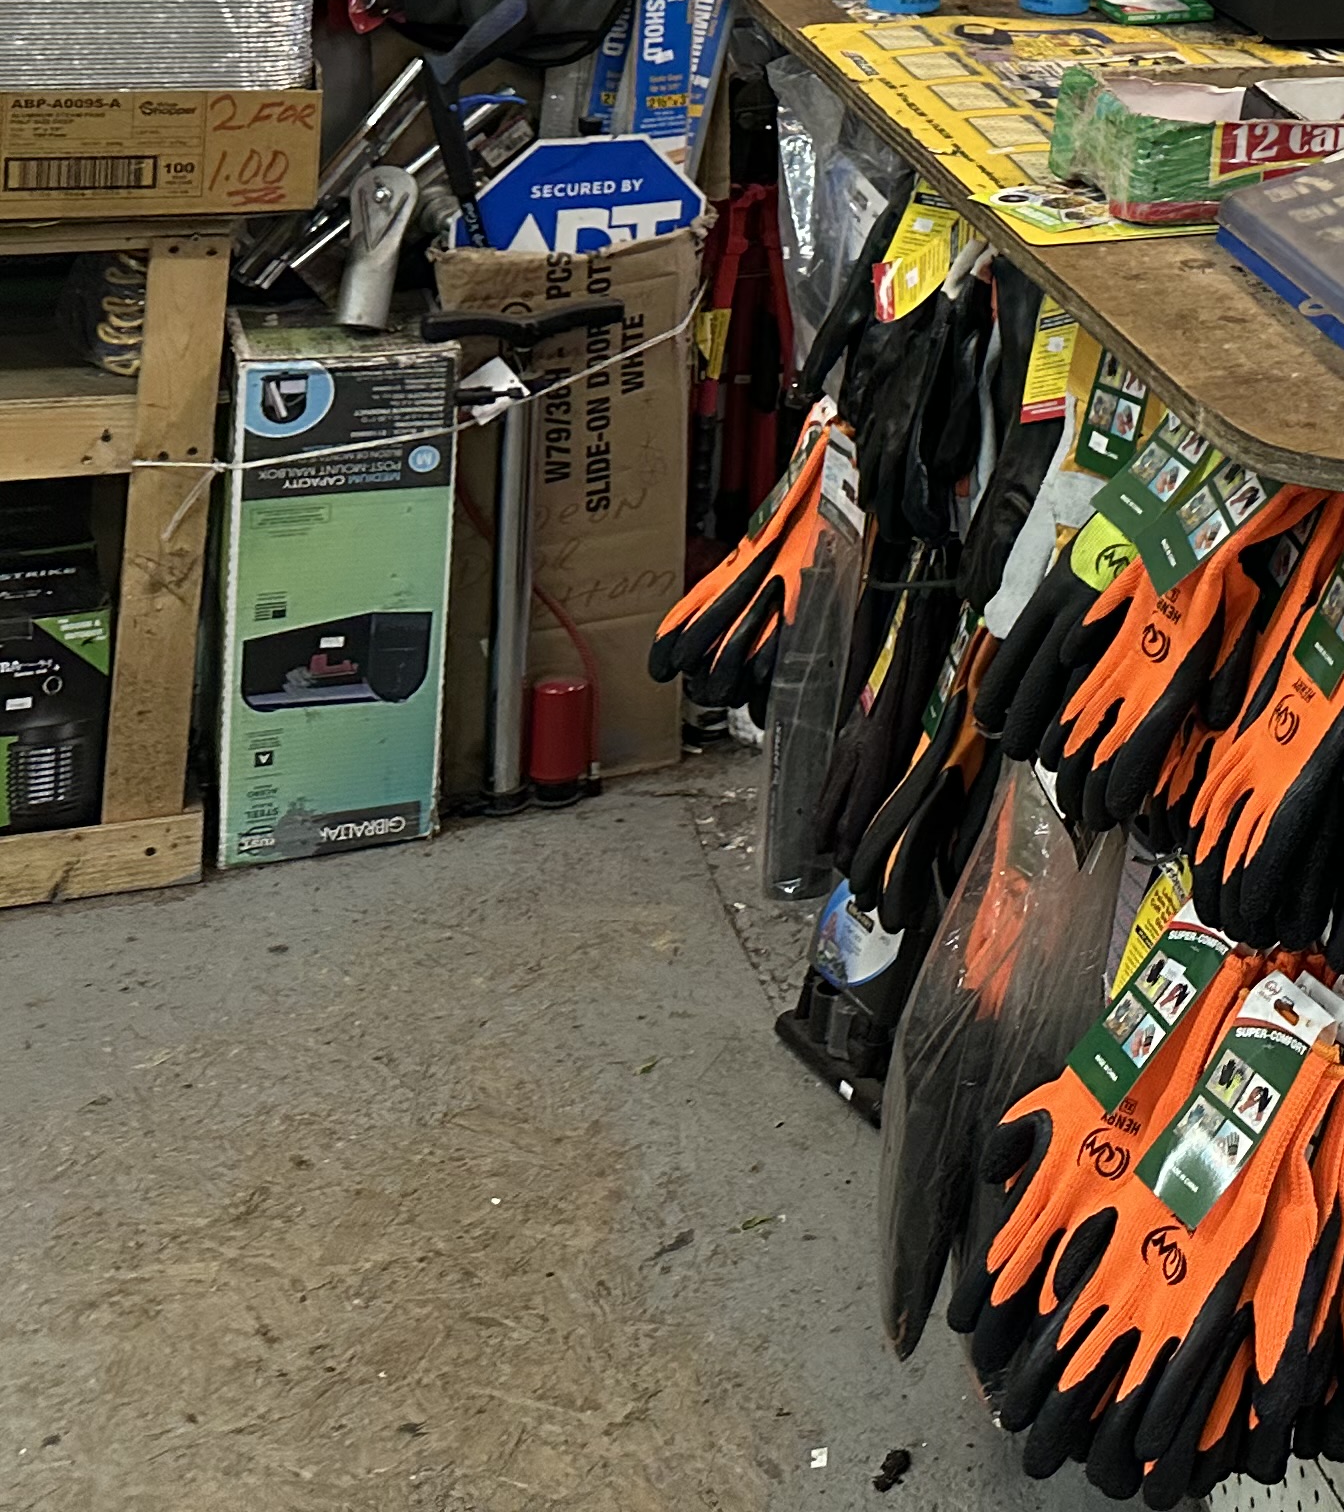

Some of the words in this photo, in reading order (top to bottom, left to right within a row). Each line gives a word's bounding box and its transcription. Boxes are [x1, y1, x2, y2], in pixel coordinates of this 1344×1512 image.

[11, 97, 121, 110] ABP-A0095-A
[209, 93, 248, 132] 2
[248, 100, 317, 131] FOR
[1232, 123, 1283, 163] 12
[163, 161, 195, 174] 100
[208, 148, 289, 192] 1.00
[530, 181, 617, 199] SECURED
[621, 177, 645, 194] BY
[505, 199, 683, 258] ADT
[545, 252, 573, 300] PCS
[621, 312, 645, 396] WHITE
[586, 391, 612, 514] SLIDE-ON
[258, 466, 317, 481] MAILBOX
[282, 475, 345, 489] CAPACITY
[349, 470, 401, 483] MEDIUM
[1167, 929, 1231, 957] SUPER-COMFORT
[1235, 1026, 1308, 1056] SUPER-COMFORT
[1100, 1112, 1142, 1136] HENRY
